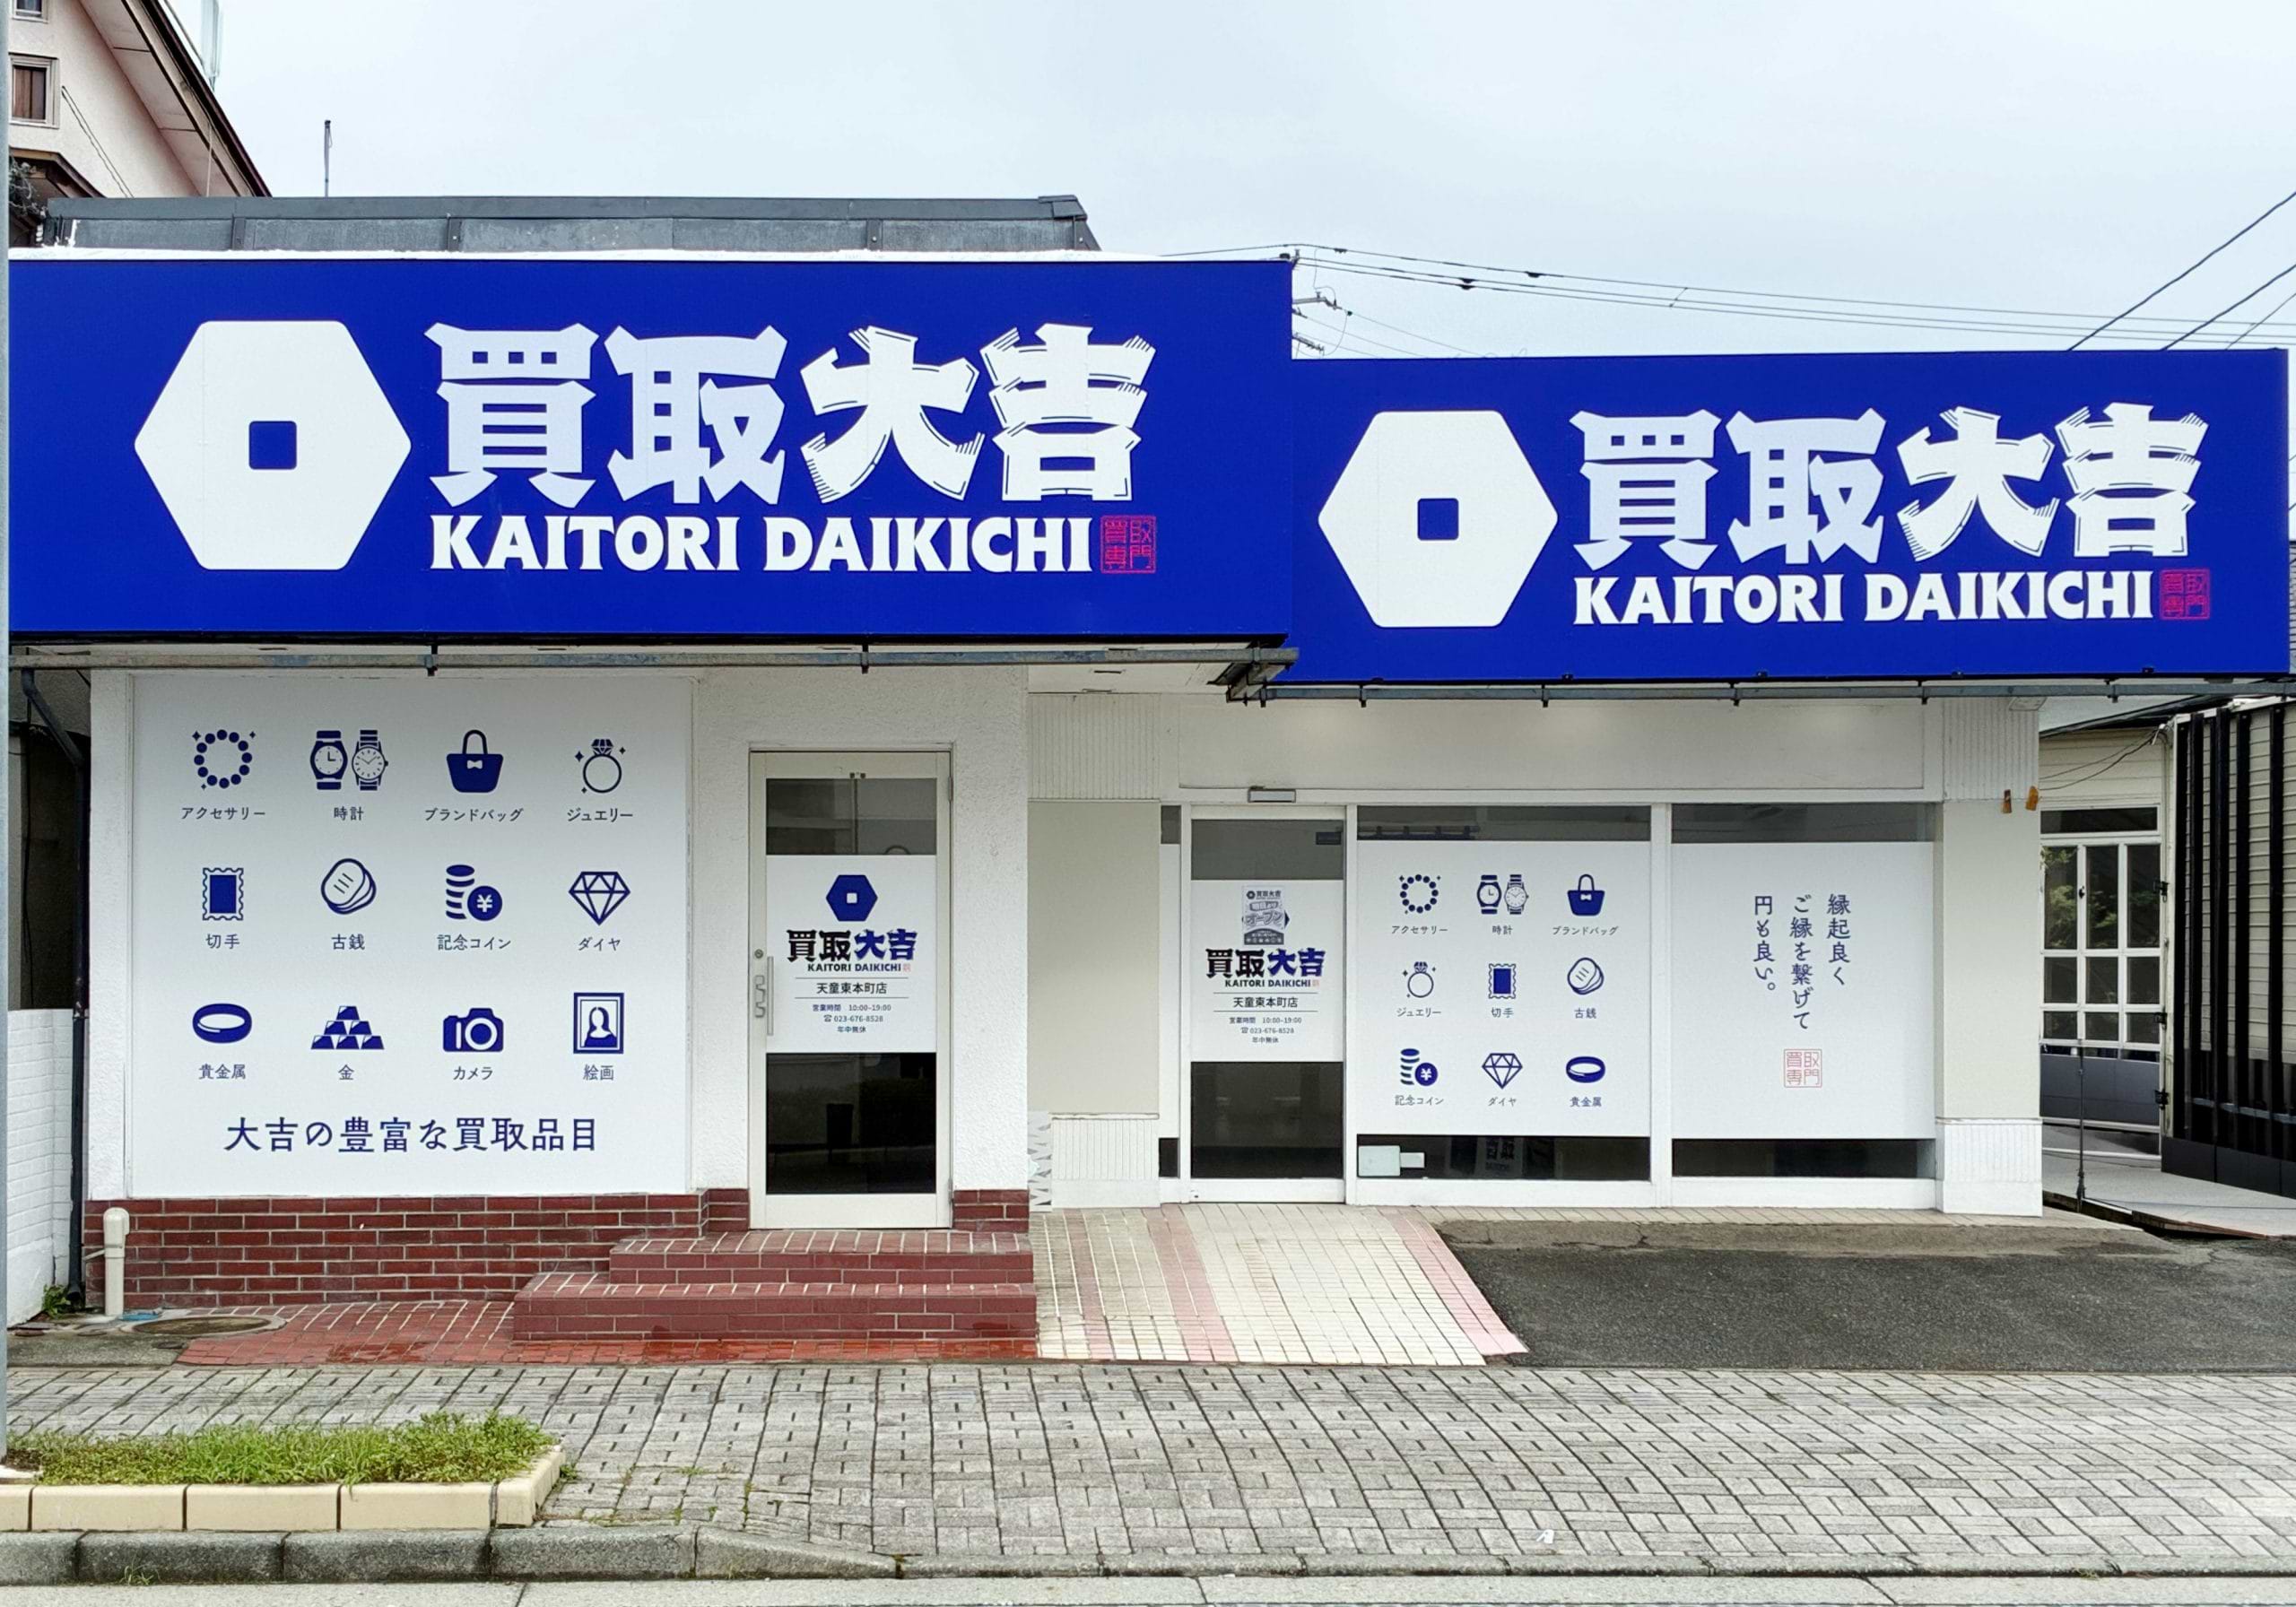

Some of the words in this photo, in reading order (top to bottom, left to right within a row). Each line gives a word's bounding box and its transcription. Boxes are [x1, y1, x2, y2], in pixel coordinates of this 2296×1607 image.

[424, 323, 1155, 507] 買取大吉
[1570, 403, 2209, 570] 買取大吉
[430, 516, 740, 571] KAITORI
[763, 517, 1092, 573] DAIKICHI
[1574, 574, 1844, 625] KAITORI
[1865, 570, 2153, 621] DAIKICHI
[181, 806, 266, 821] アクセサリー
[333, 805, 365, 821] 時計
[424, 807, 525, 822] ブランドバッグ
[567, 807, 634, 823] ジュエリー
[1391, 925, 1448, 935] アクセサリー
[1492, 925, 1513, 935] 時計
[1552, 925, 1620, 936] ブランドバッグ
[204, 933, 240, 950] 切手
[331, 933, 366, 951] 古銭
[436, 933, 511, 951] 記念コイン
[578, 936, 621, 952] ダイヤ
[787, 928, 918, 962] 買取大吉
[1752, 895, 1776, 991] 円も良い。
[1826, 893, 1852, 986] 縁起良く
[807, 963, 851, 972] KAITORI
[854, 963, 901, 972] DAIKICHI
[1205, 947, 1326, 978] 買取大吉
[1788, 893, 1814, 1029] ご縁を繋げて
[817, 982, 887, 995] 天童東本町店
[1224, 979, 1265, 987] KAITORI
[1267, 979, 1310, 987] DAIKICHI
[812, 1003, 842, 1012] 営業時間
[1232, 996, 1299, 1008] 天童東本町店
[1396, 1006, 1442, 1018] ジュエリー
[1491, 1006, 1514, 1019] 切手
[1574, 1007, 1597, 1020] 古銭
[198, 1063, 247, 1081] 貴金属
[337, 1064, 355, 1081] 金
[453, 1065, 493, 1081] カメラ
[582, 1064, 614, 1081] 絵画
[1394, 1094, 1445, 1107] 記念コイン
[1487, 1096, 1518, 1108] ダイヤ
[1570, 1096, 1603, 1108] 貴金属
[224, 1116, 595, 1152] 大吉の豊富な買取品目
